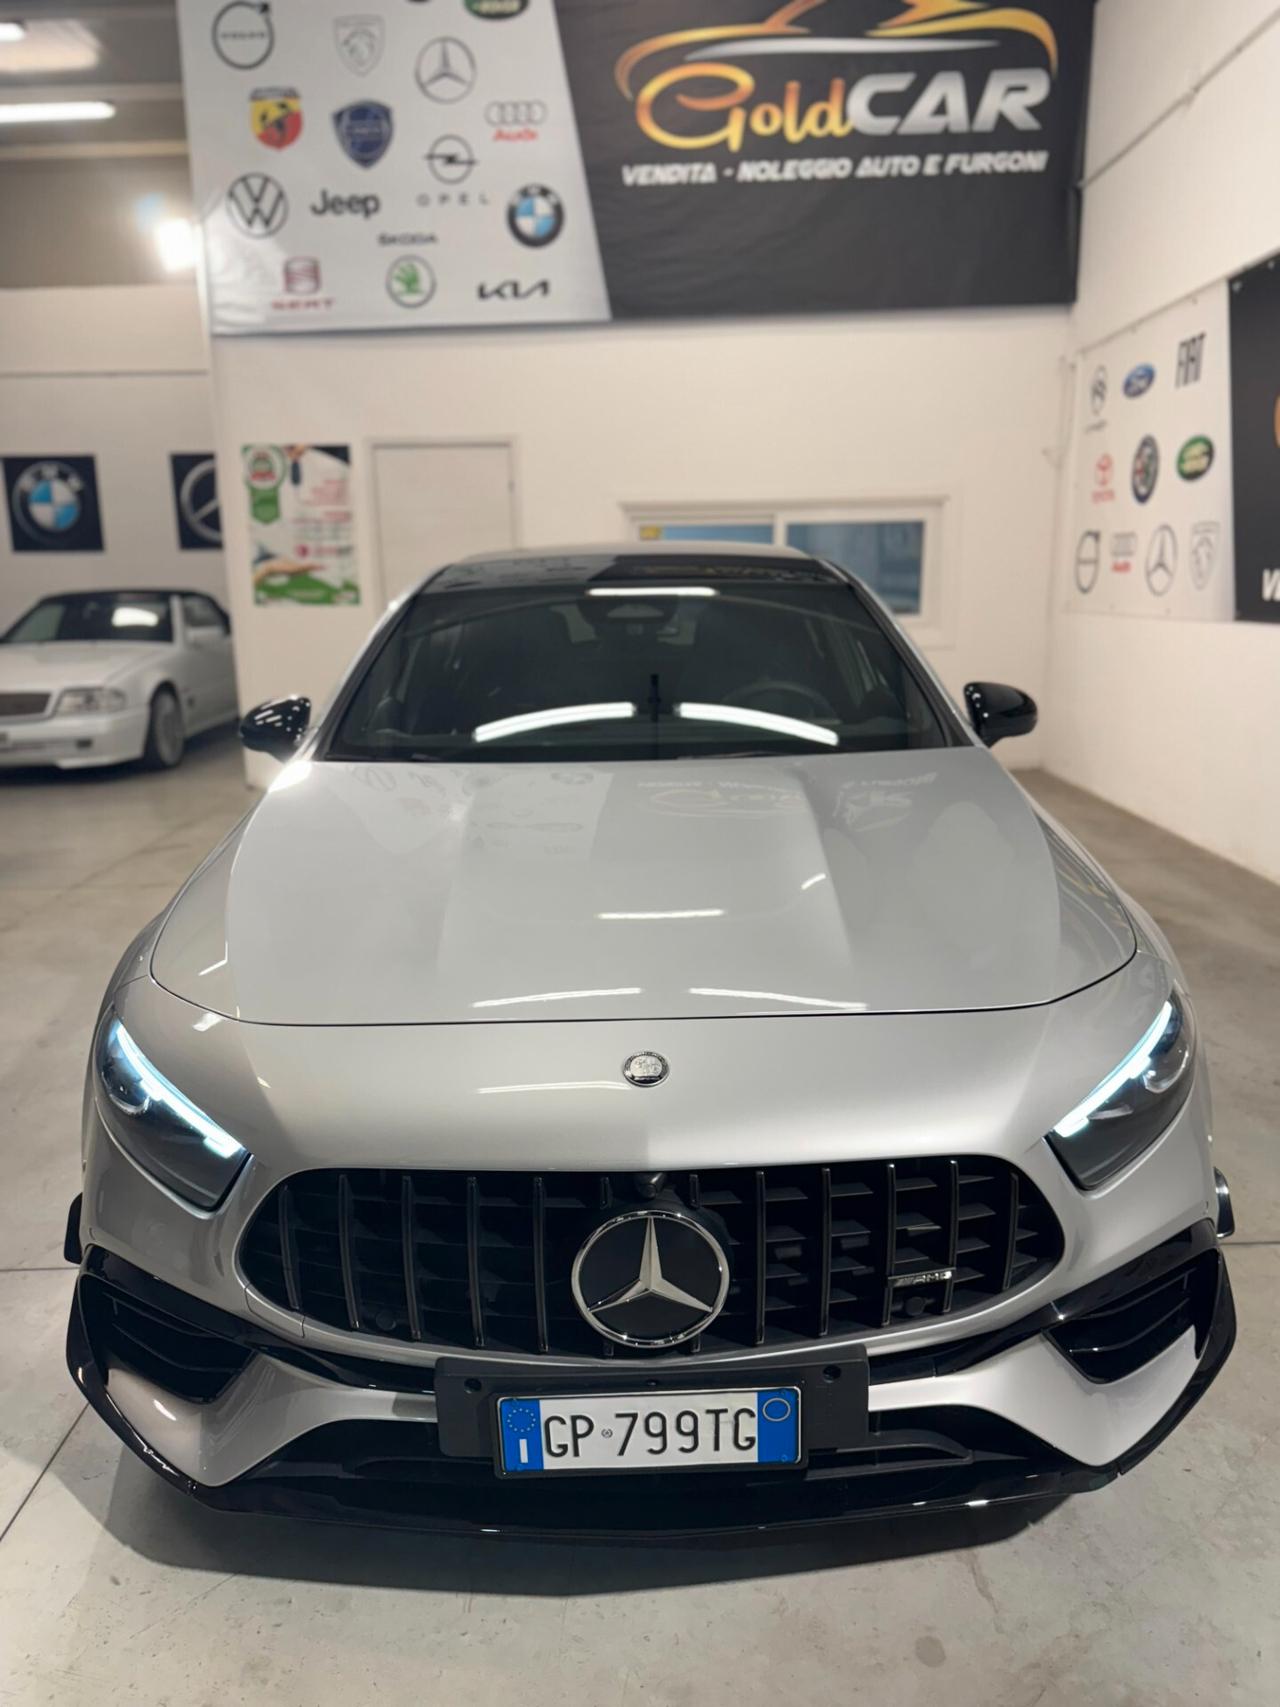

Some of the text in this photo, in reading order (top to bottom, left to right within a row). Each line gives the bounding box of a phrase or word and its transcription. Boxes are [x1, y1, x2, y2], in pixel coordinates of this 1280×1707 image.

[622, 163, 717, 186] VENDITA
[737, 157, 850, 182] NOLEGGIO
[855, 155, 918, 178] AUTO
[923, 155, 940, 175] E
[944, 151, 1048, 174] FURGONI
[310, 189, 381, 219] Jeep
[416, 193, 490, 206] OPEL
[477, 279, 550, 300] KIA
[543, 1414, 595, 1458] GP
[614, 1407, 757, 1456] 799TG
